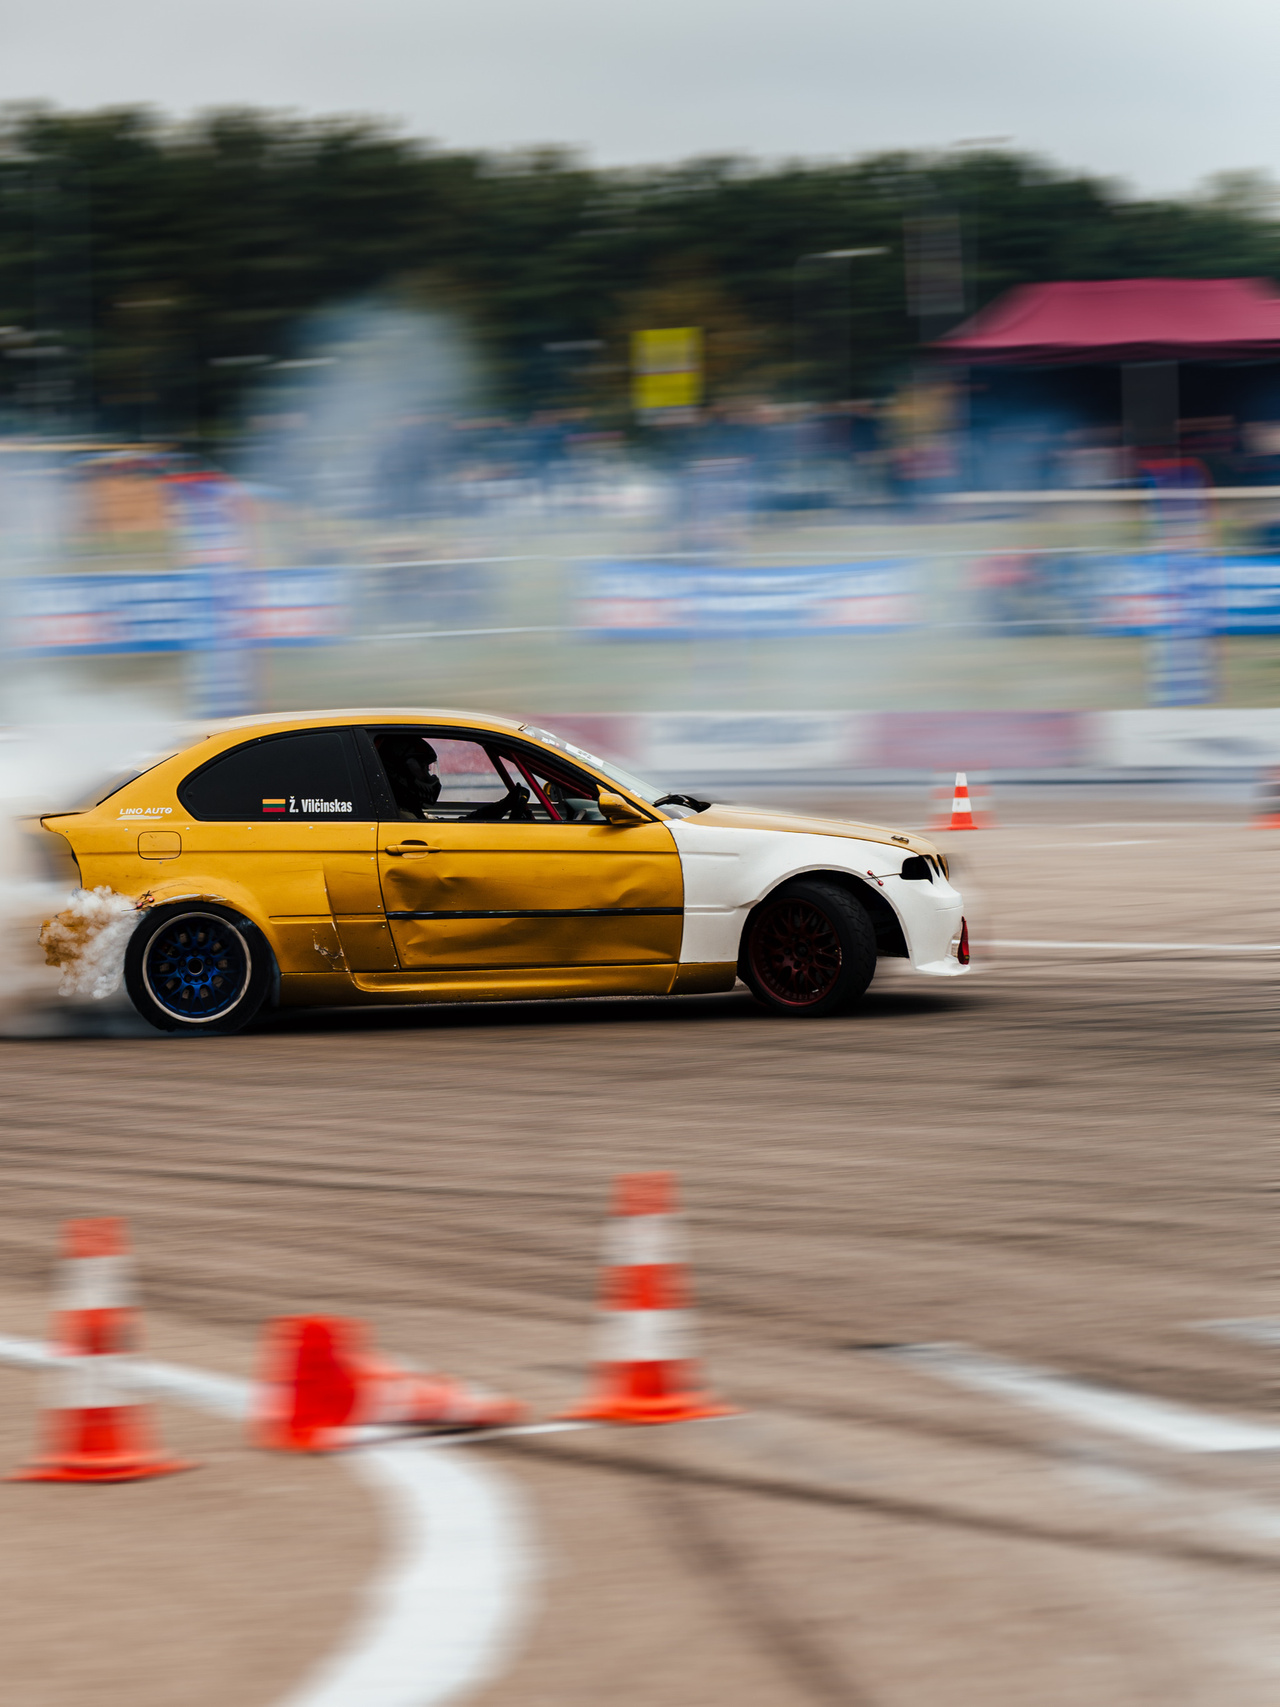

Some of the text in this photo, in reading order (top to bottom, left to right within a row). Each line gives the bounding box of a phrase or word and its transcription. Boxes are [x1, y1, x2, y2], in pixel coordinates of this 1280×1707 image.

[289, 795, 353, 813] Ž. Vilčinskas
[119, 807, 173, 815] LINO AUTO
